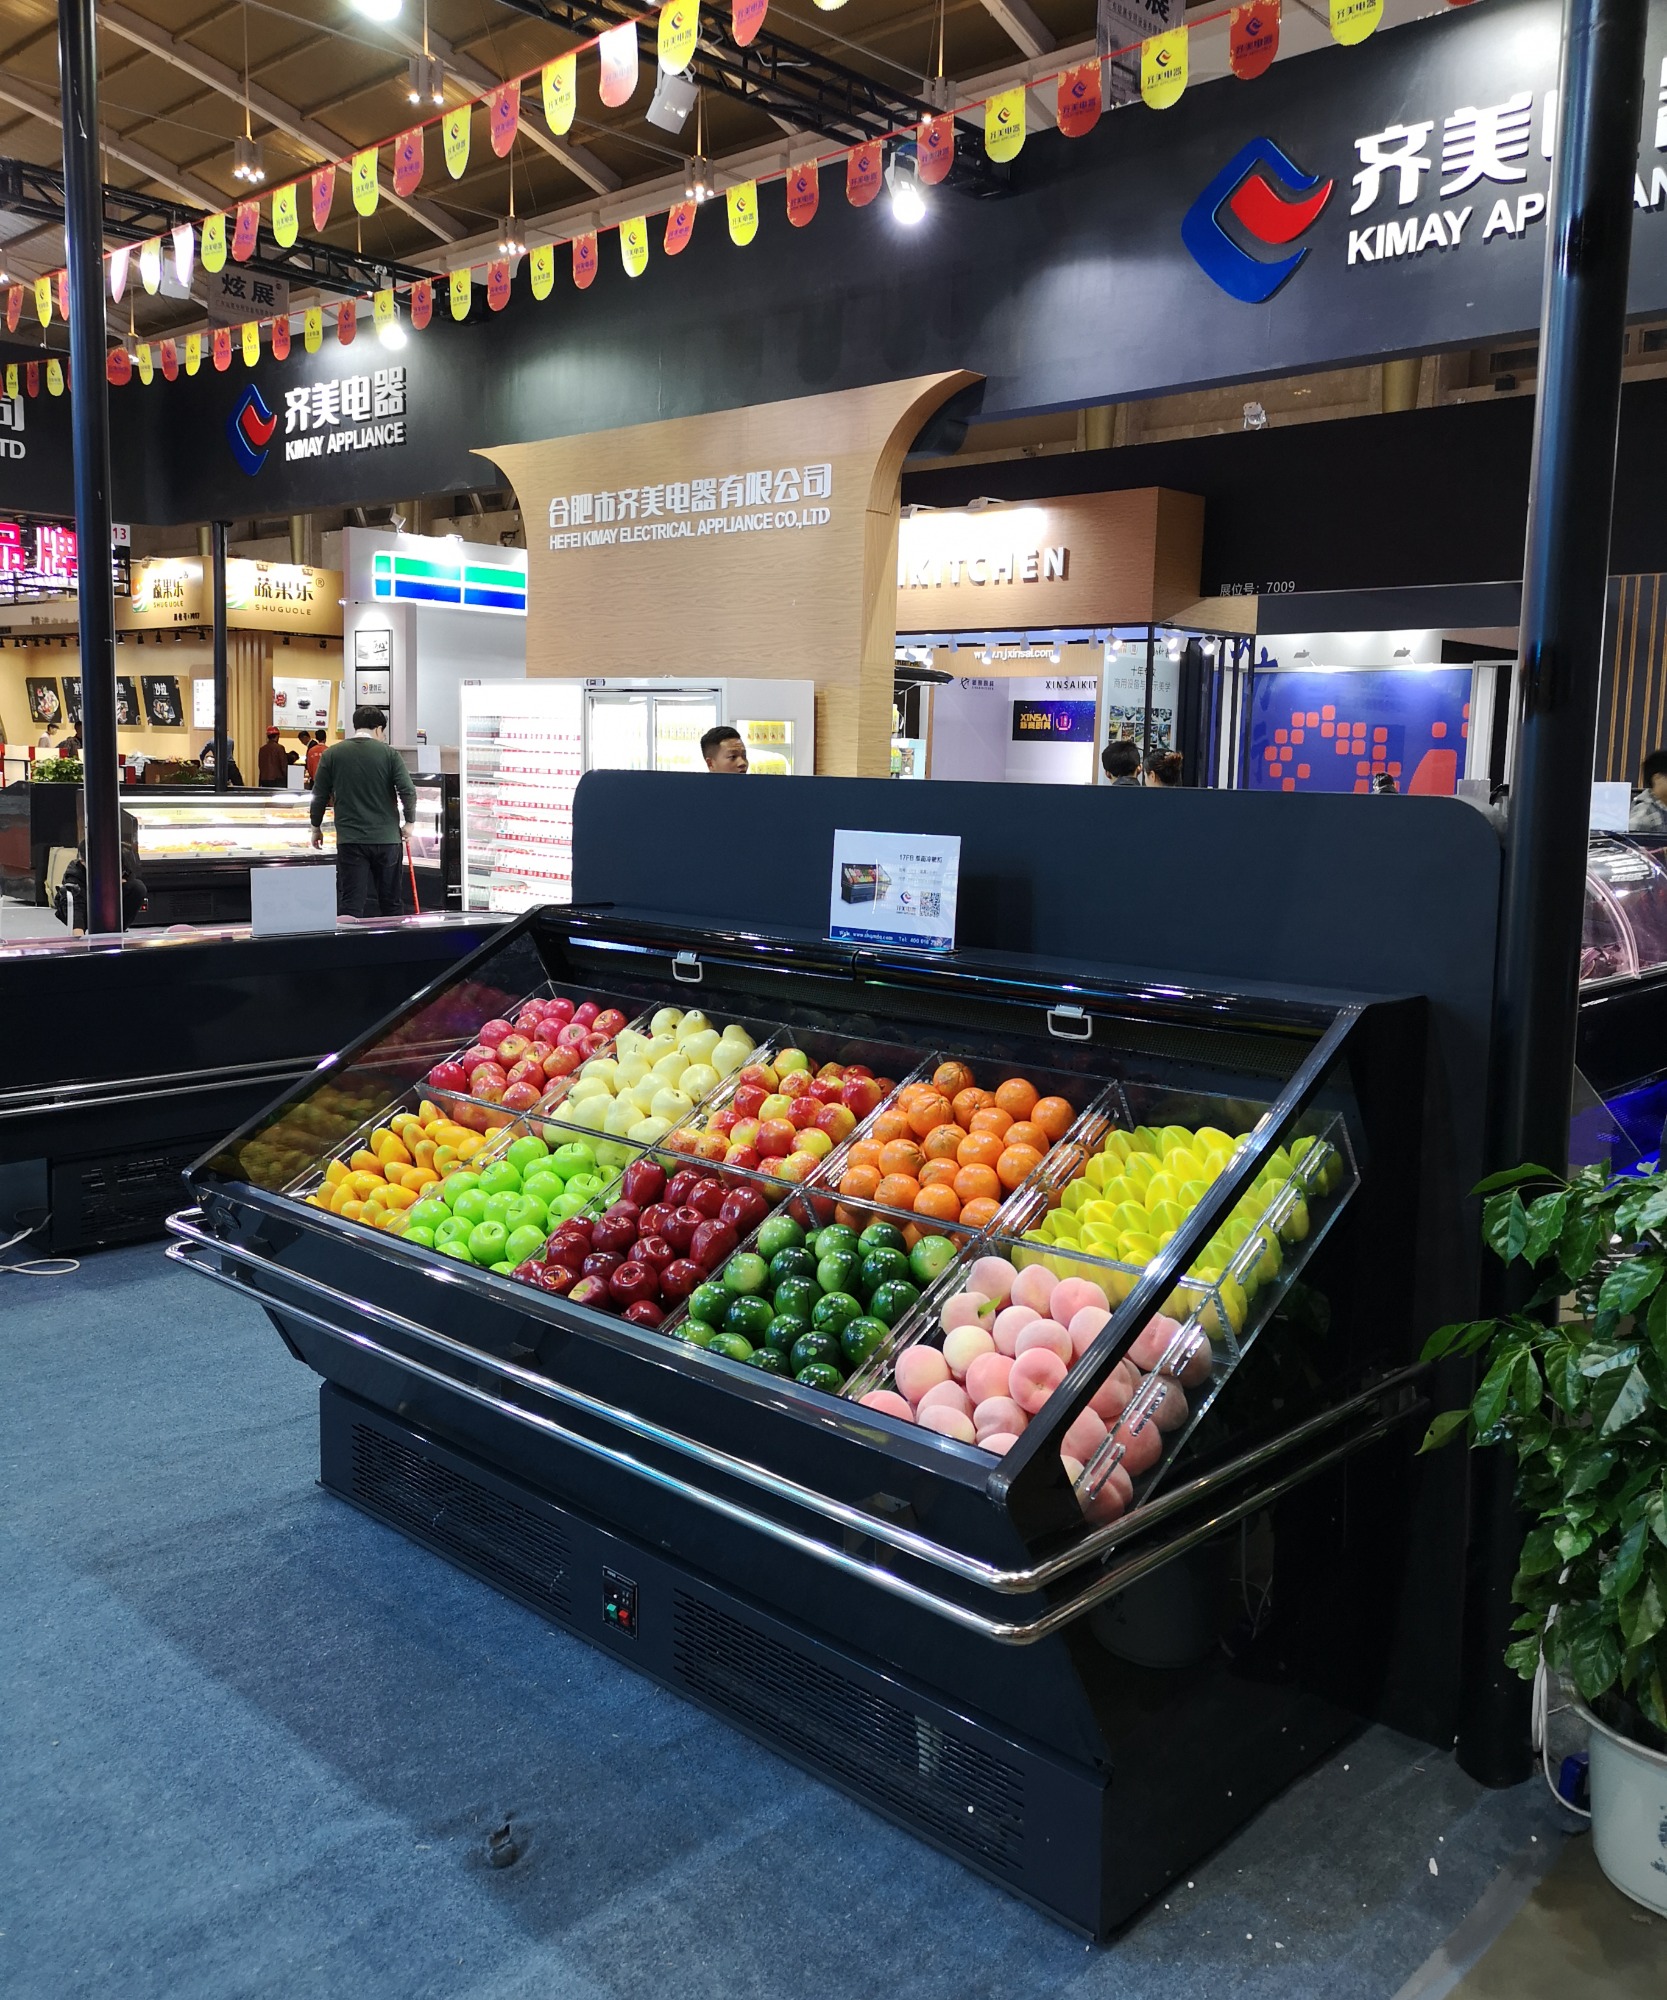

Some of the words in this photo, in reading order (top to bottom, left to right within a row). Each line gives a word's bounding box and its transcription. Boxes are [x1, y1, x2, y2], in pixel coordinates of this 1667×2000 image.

[1347, 205, 1473, 266] KIMAY
[221, 273, 276, 307] 炫展
[284, 366, 405, 434] 齐美电器
[285, 434, 325, 462] KIMAY
[326, 421, 405, 455] APPLIANCE
[548, 463, 833, 528] 合肥市齐美电器有限公司
[549, 532, 582, 550] HEFEI
[582, 527, 619, 547] KIMAY
[619, 521, 696, 543] ELECTRICAL
[696, 512, 774, 536] APPLIANCE
[254, 577, 314, 602] 蔬果乐
[255, 604, 312, 616] SHUGUOLE
[1020, 713, 1052, 722] XINSAI
